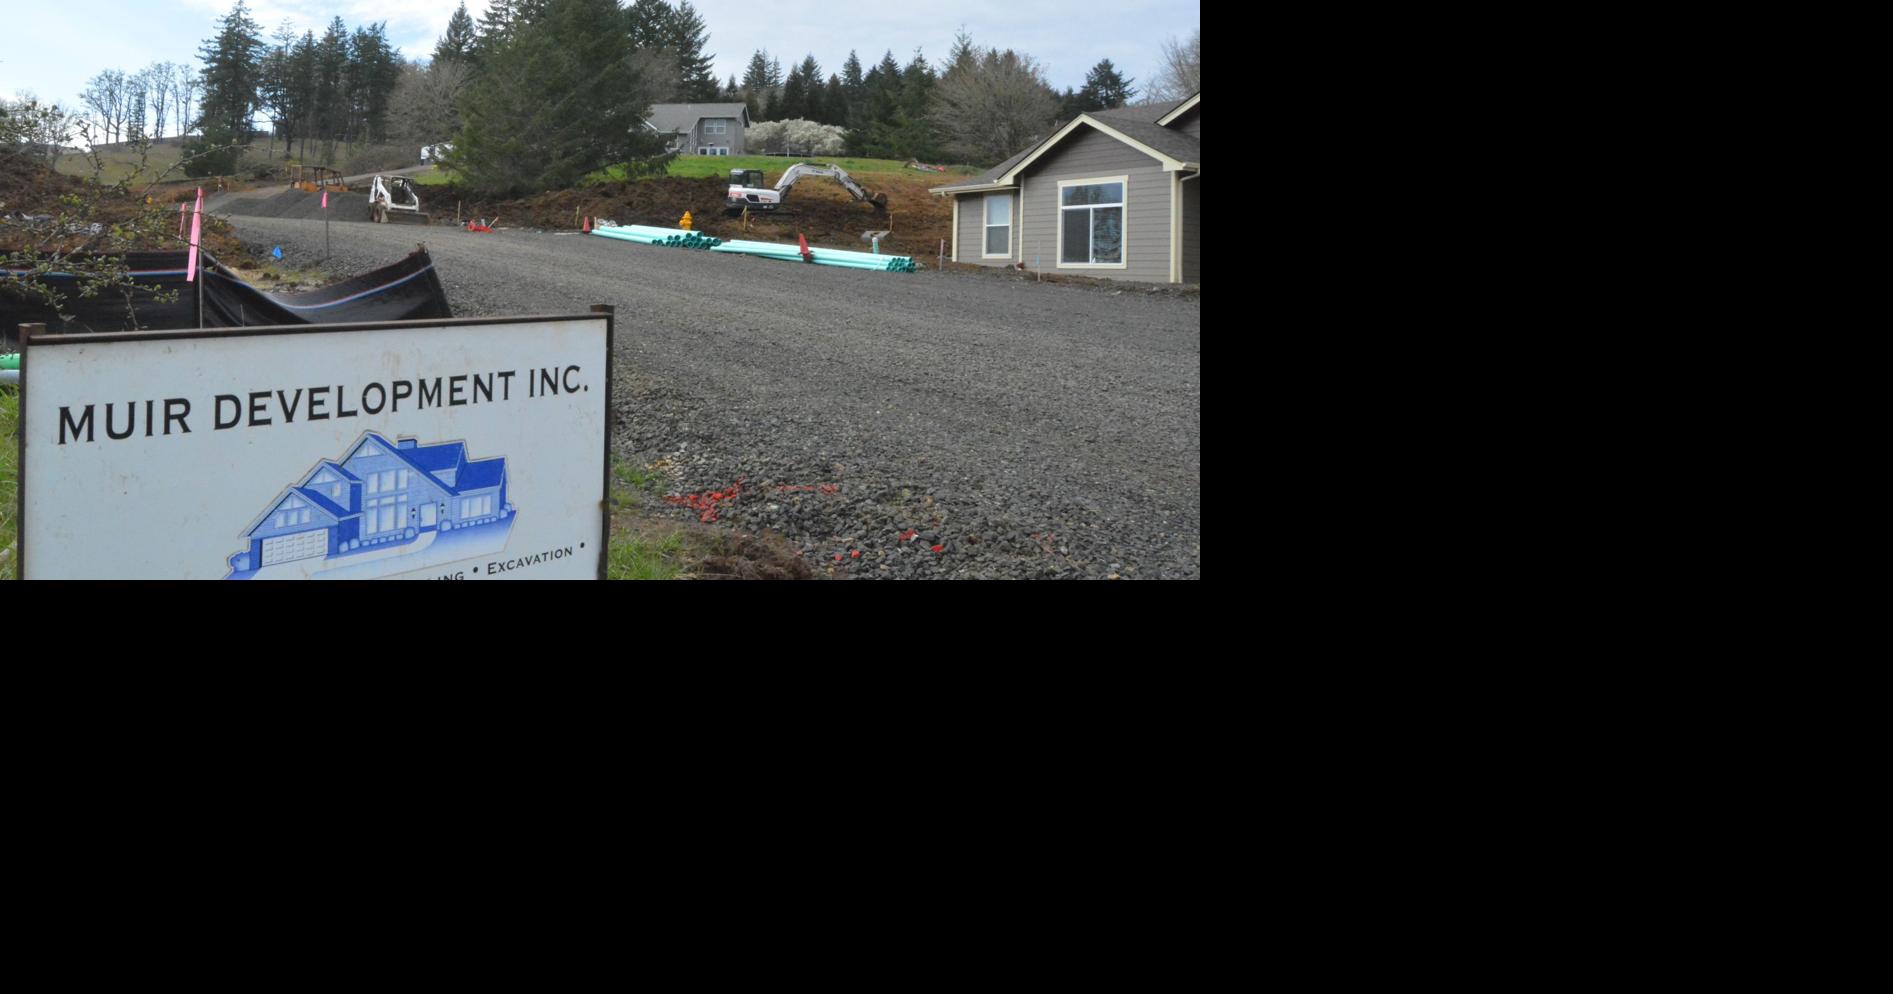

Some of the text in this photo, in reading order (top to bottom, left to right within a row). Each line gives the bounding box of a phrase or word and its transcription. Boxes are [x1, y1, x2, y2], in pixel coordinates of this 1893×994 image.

[58, 365, 588, 445] MUIR DEVELOPMENT INC.
[487, 547, 573, 575] EXCAVATION
